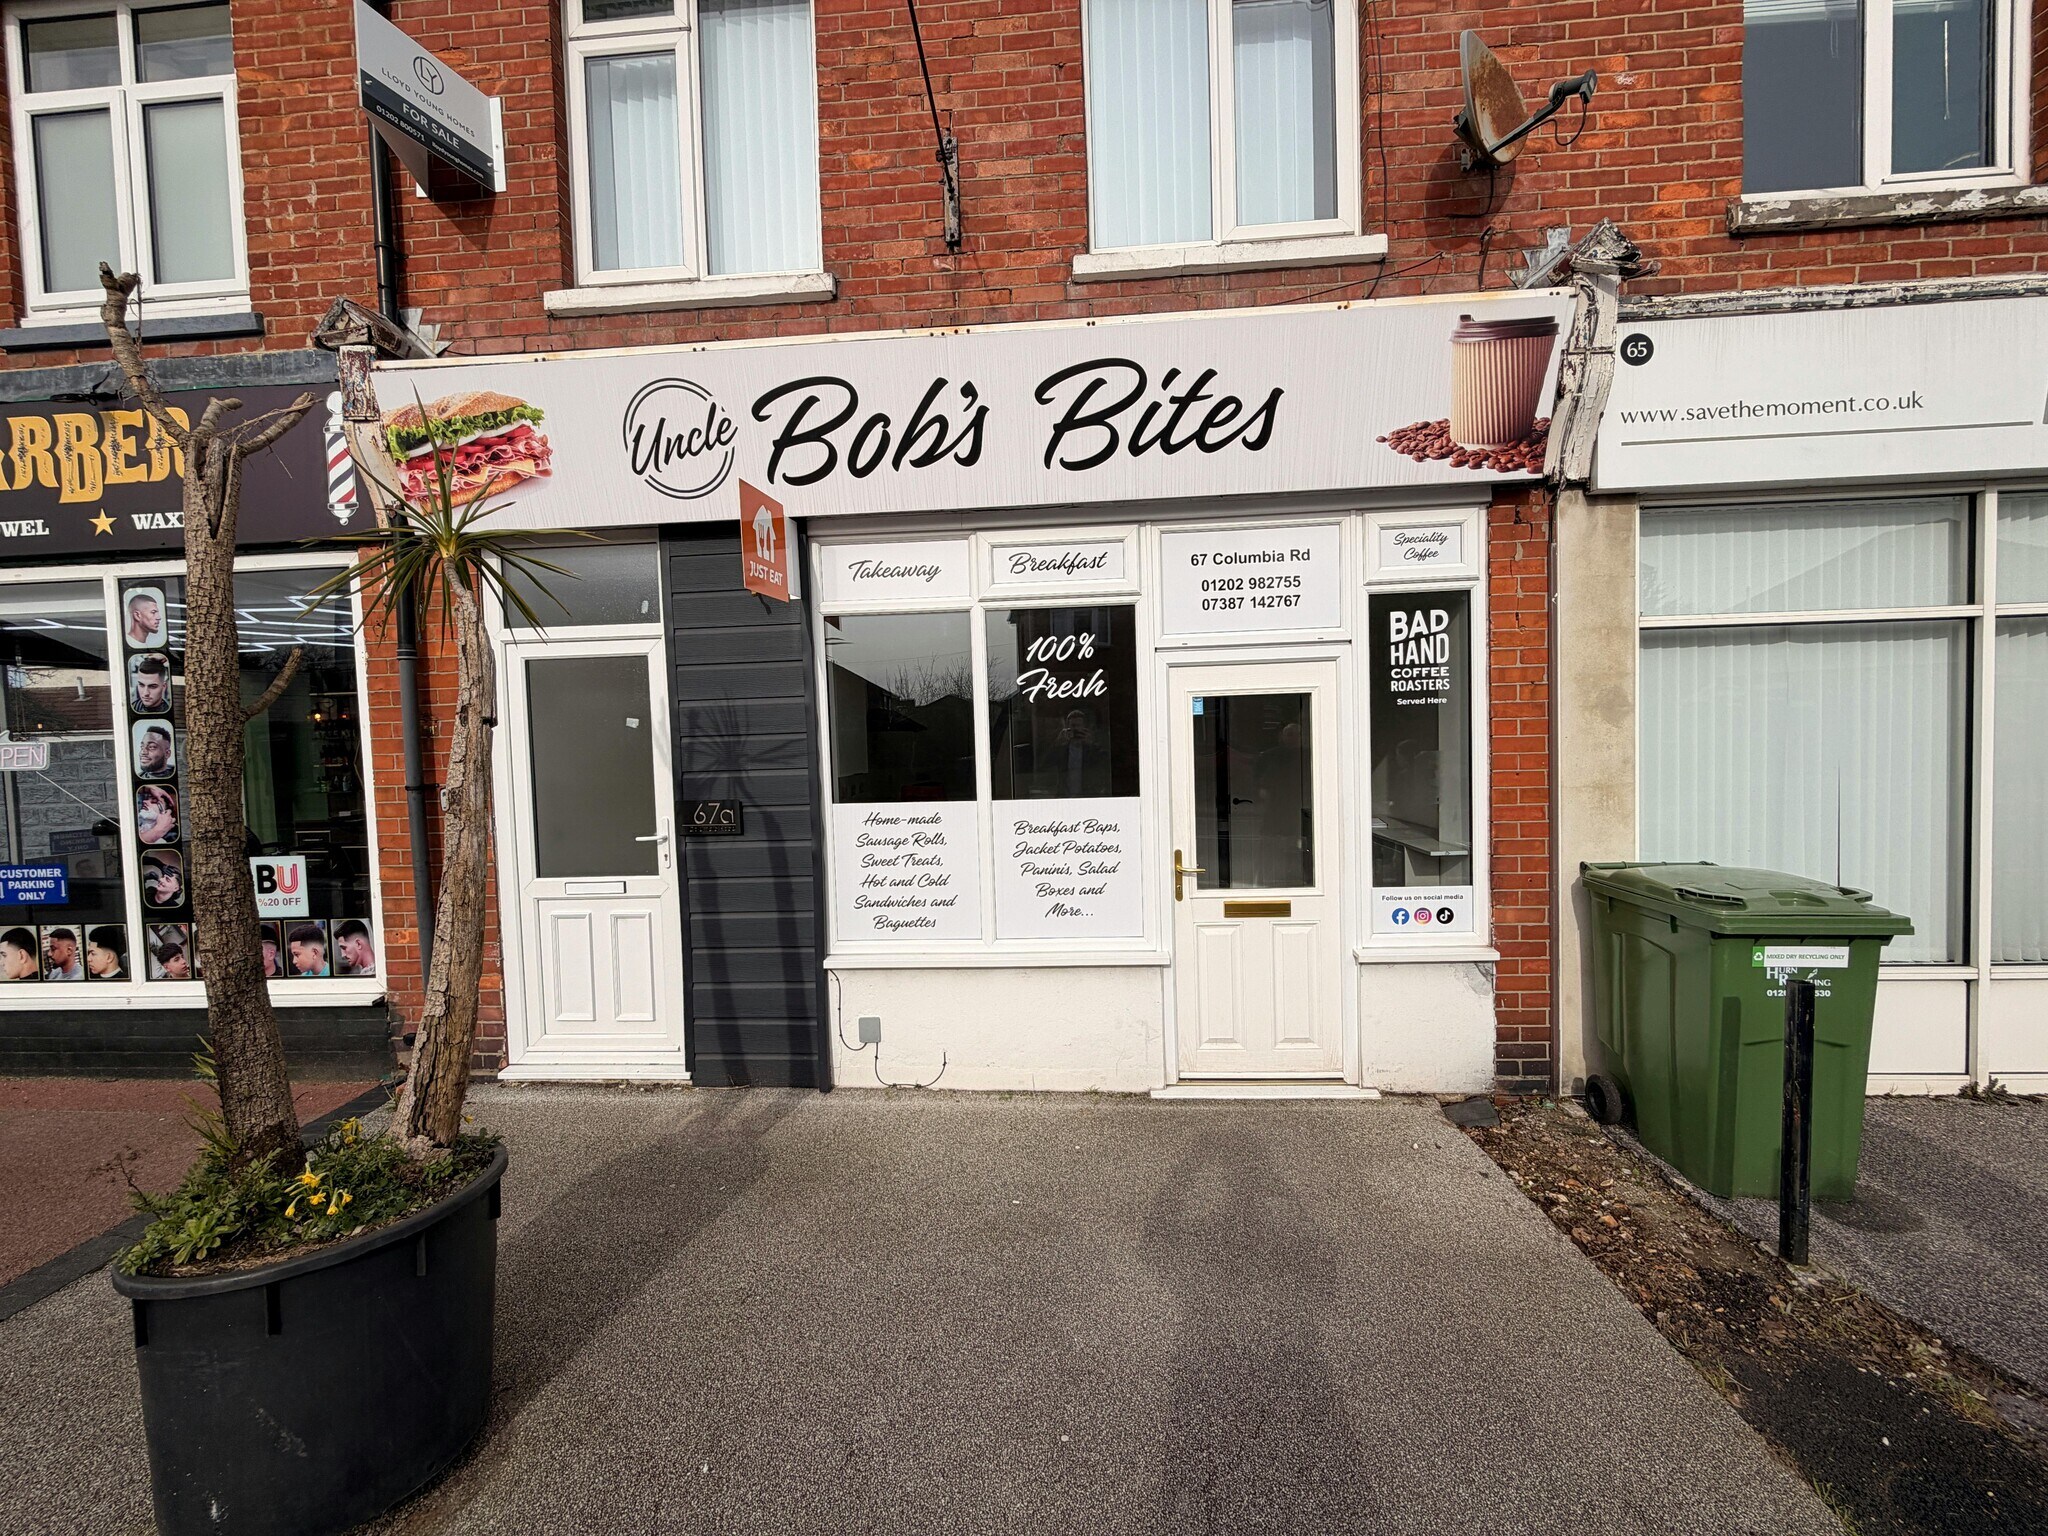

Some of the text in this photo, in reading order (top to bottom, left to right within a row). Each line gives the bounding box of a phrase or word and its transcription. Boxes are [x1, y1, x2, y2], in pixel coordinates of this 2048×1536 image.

[381, 67, 475, 137] LLOYD YOUNG HOMES
[376, 105, 399, 125] 01202
[402, 103, 460, 149] FOR SALE
[1627, 341, 1648, 357] 65
[1621, 391, 1924, 424] www.savethemoment.co.uk
[631, 357, 1285, 487] Uncle Bob's Bites
[0, 407, 190, 504] RBER
[131, 511, 185, 530] WAX
[1393, 532, 1449, 548] Speciality
[1008, 551, 1109, 576] Breakfast
[1190, 549, 1311, 567] 67 Columbia Rd
[1403, 548, 1440, 561] Coffee
[749, 560, 783, 586] JUST EAT
[848, 560, 942, 583] Takeaway
[1201, 575, 1301, 592] 01202 982755
[1201, 595, 1301, 611] 07387 142767
[1389, 609, 1449, 643] BAD
[1026, 632, 1096, 663] 100%
[1390, 632, 1449, 666] HAND
[1391, 667, 1449, 679] COFFEE
[1016, 668, 1108, 703] Fresh
[1390, 678, 1450, 692] ROASTERS
[1396, 696, 1447, 706] Served Here
[693, 802, 735, 825] 67a
[862, 811, 943, 827] Home-made
[1013, 818, 1121, 837] Breakfast Baps,
[855, 831, 948, 850] Sausage Rolls,
[1012, 839, 1122, 858] Jacket Potatoes,
[860, 852, 944, 868] Sweet Treats,
[1020, 860, 1121, 876] Paninis, Salad
[0, 868, 62, 879] CUSTOMER
[859, 872, 951, 889] Hot and Cold
[8, 880, 55, 890] PARKING
[1034, 882, 1107, 898] Boxes and
[18, 891, 46, 901] ONLY
[853, 894, 959, 910] Sandwiches and
[1044, 902, 1094, 919] More...
[872, 914, 937, 932] Baguettes
